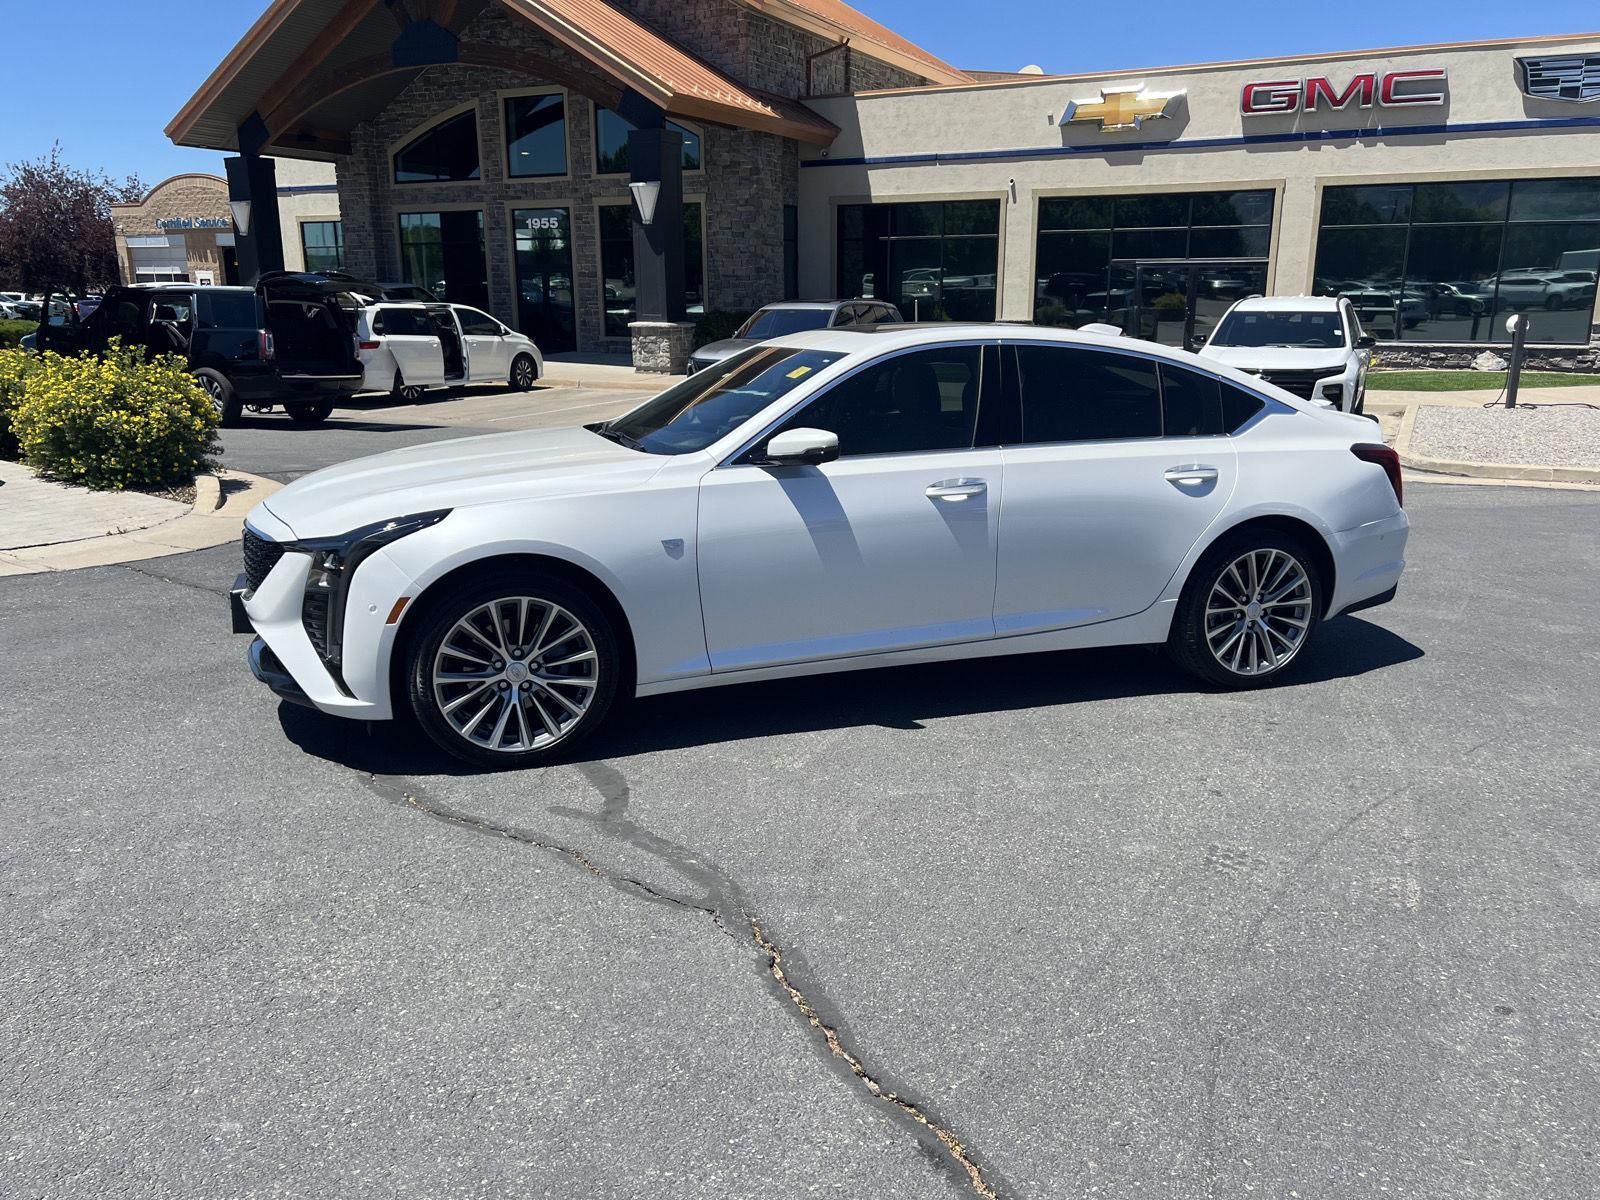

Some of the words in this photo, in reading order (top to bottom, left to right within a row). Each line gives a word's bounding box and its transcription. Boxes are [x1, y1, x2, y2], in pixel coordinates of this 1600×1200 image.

[1240, 66, 1448, 117] GMC
[155, 216, 192, 229] Certified
[194, 216, 229, 228] Service
[525, 217, 559, 229] 1955
